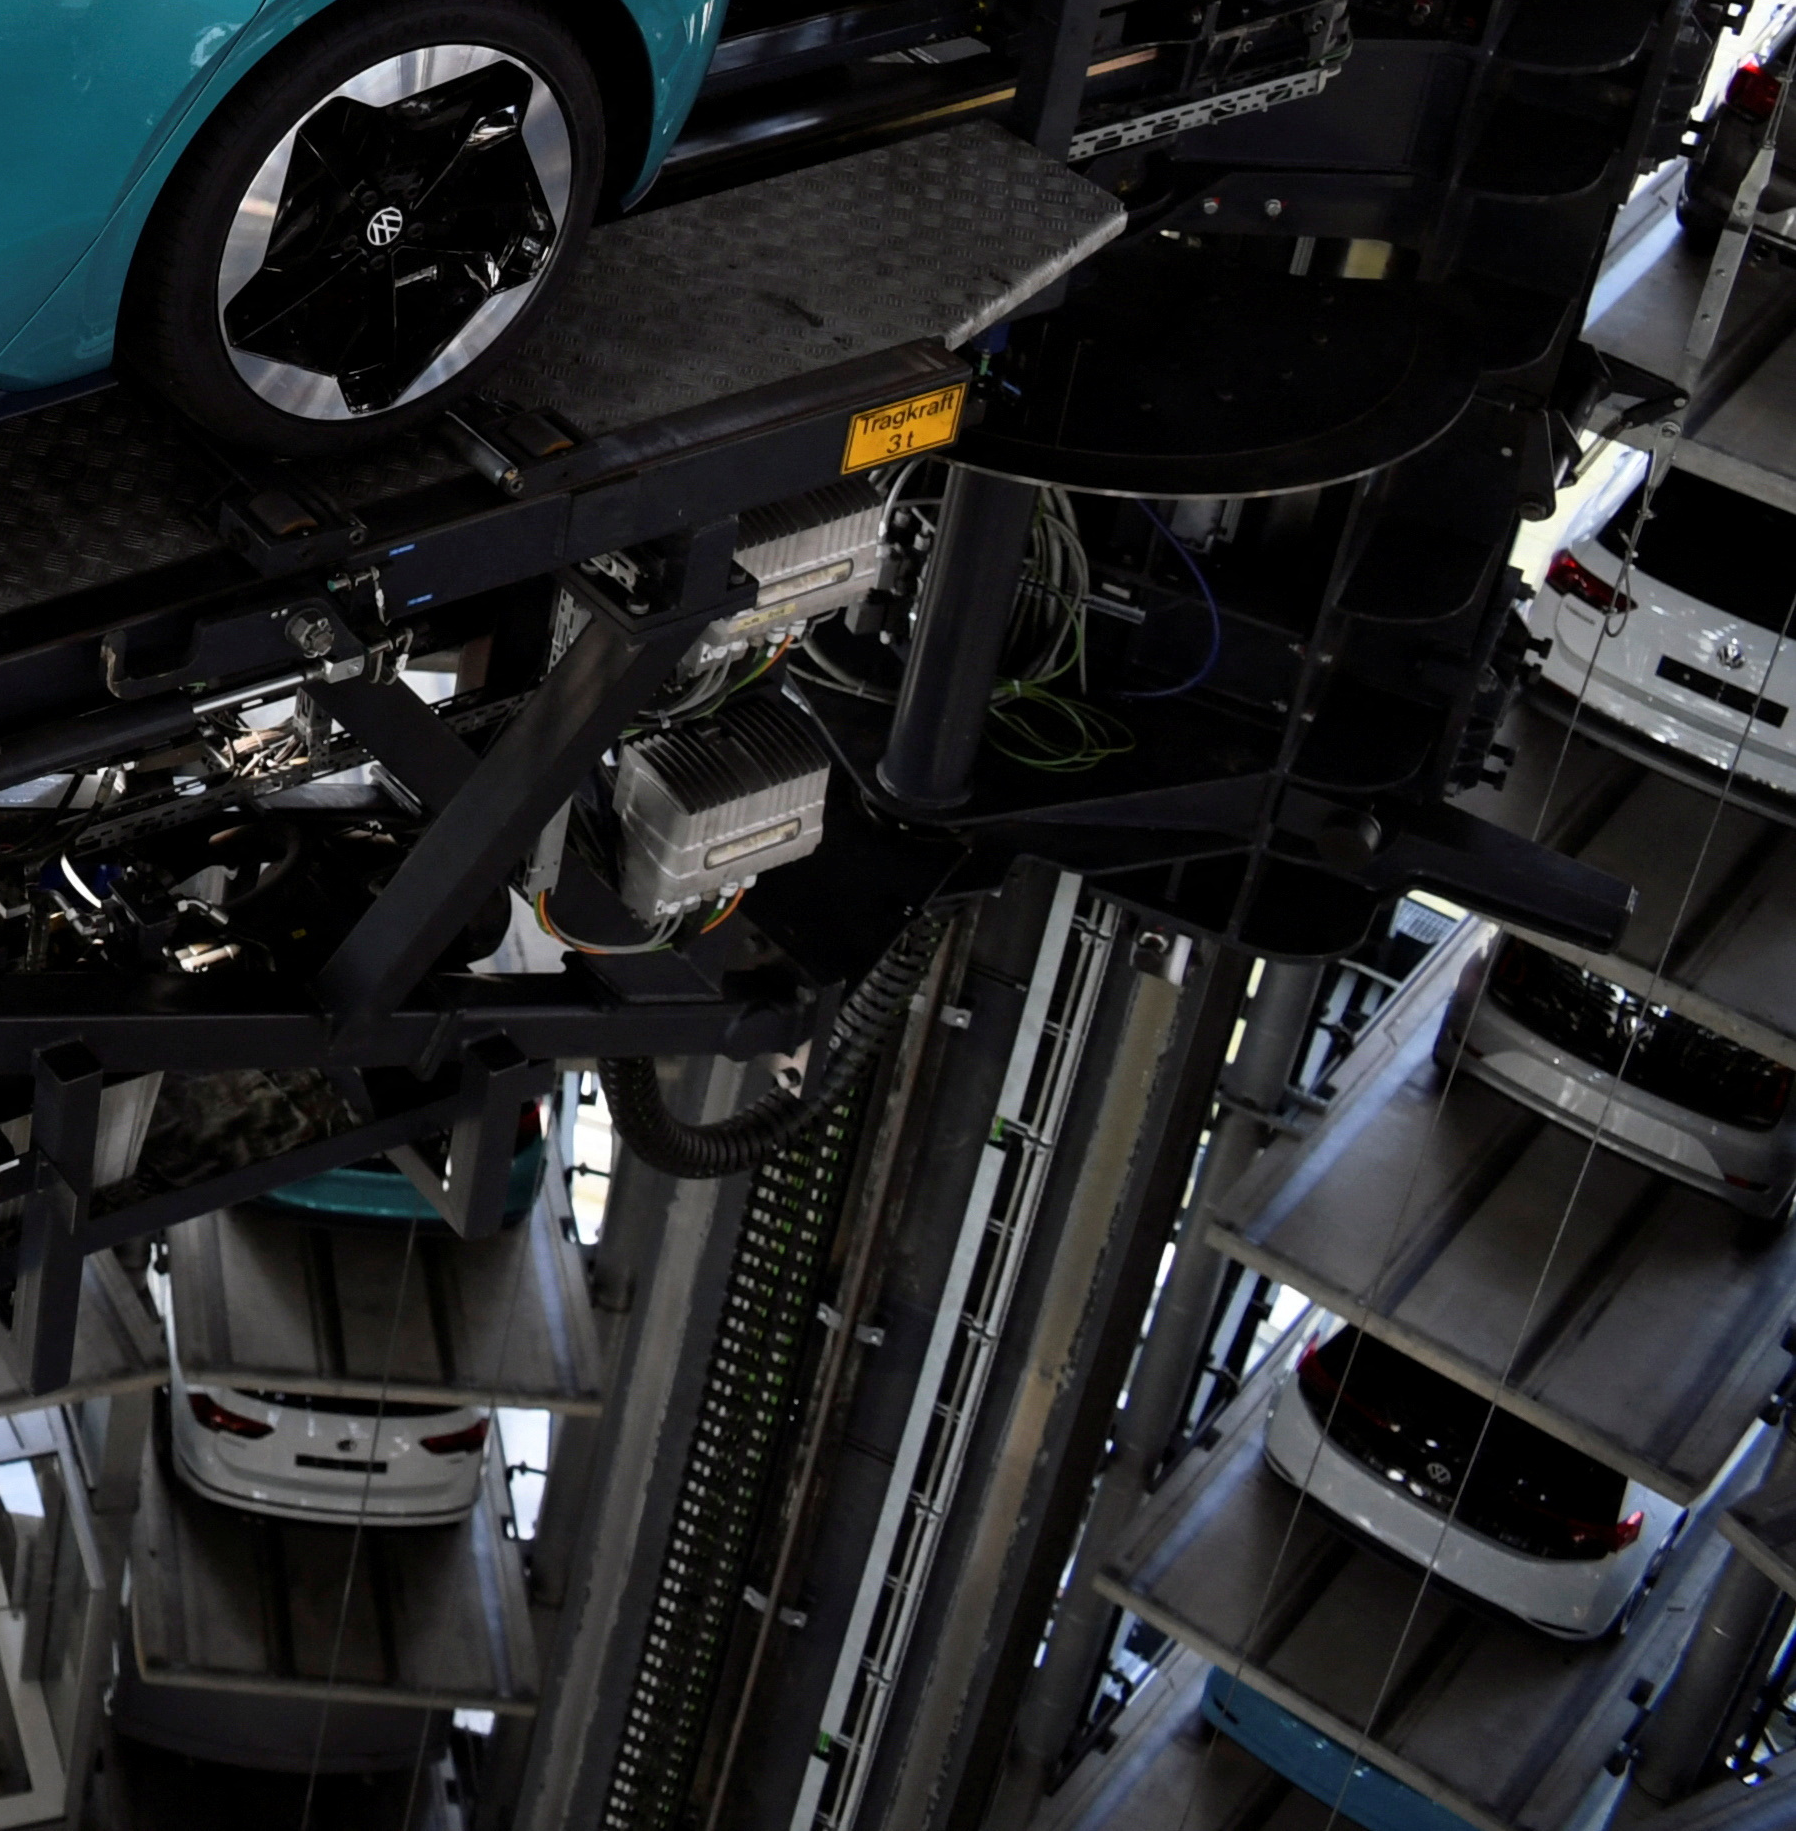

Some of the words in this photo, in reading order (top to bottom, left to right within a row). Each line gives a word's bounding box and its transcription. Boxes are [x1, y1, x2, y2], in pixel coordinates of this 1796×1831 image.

[859, 392, 954, 435] Tragkraft
[886, 432, 902, 454] 3
[906, 430, 915, 449] t
